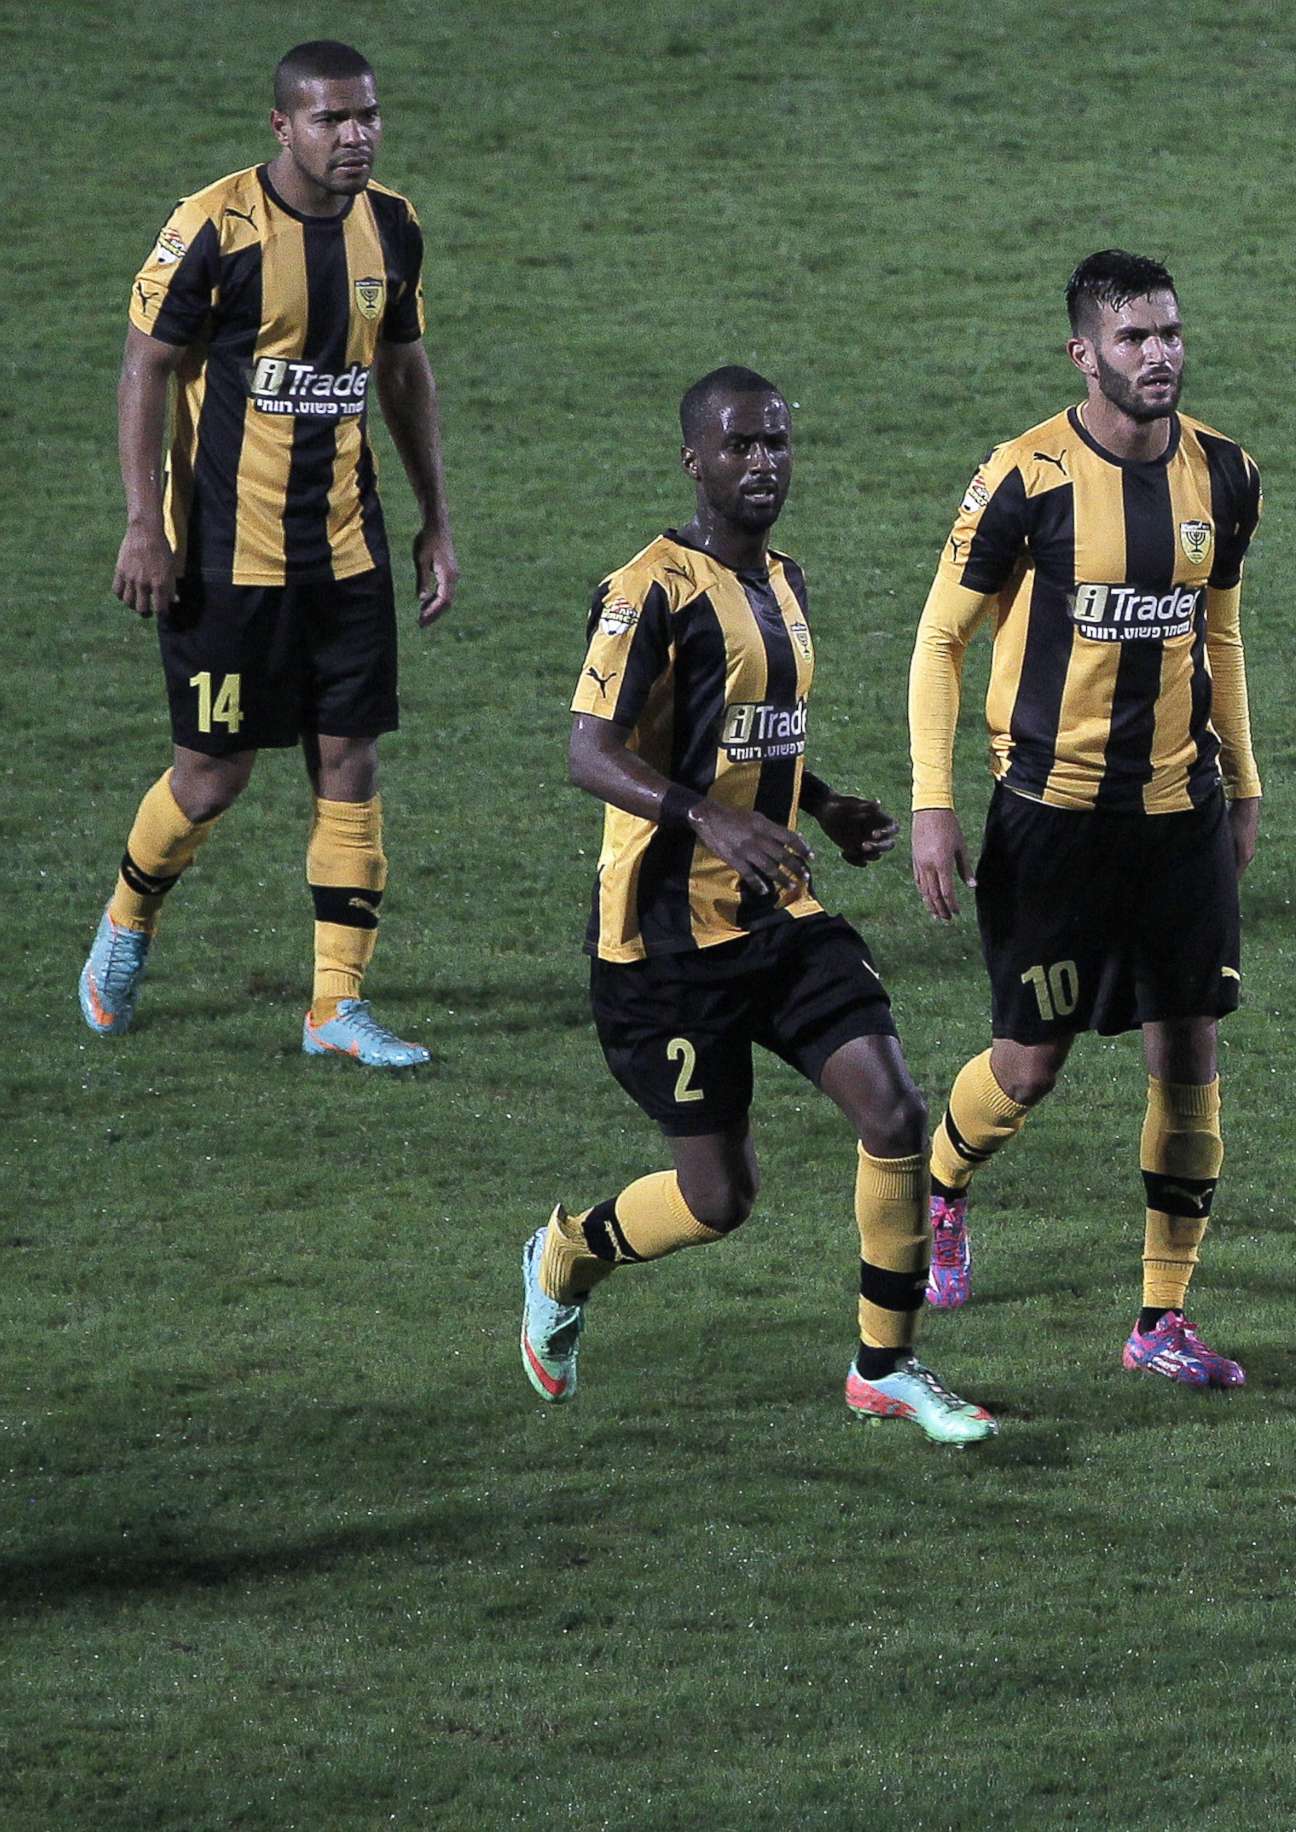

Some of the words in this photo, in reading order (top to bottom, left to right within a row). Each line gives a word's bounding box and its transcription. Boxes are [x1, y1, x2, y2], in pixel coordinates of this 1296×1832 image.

[252, 360, 370, 396] iTrade
[189, 670, 244, 733] 14
[724, 701, 808, 741] iTrad
[1020, 959, 1079, 1021] 10
[665, 1037, 704, 1102] 2
